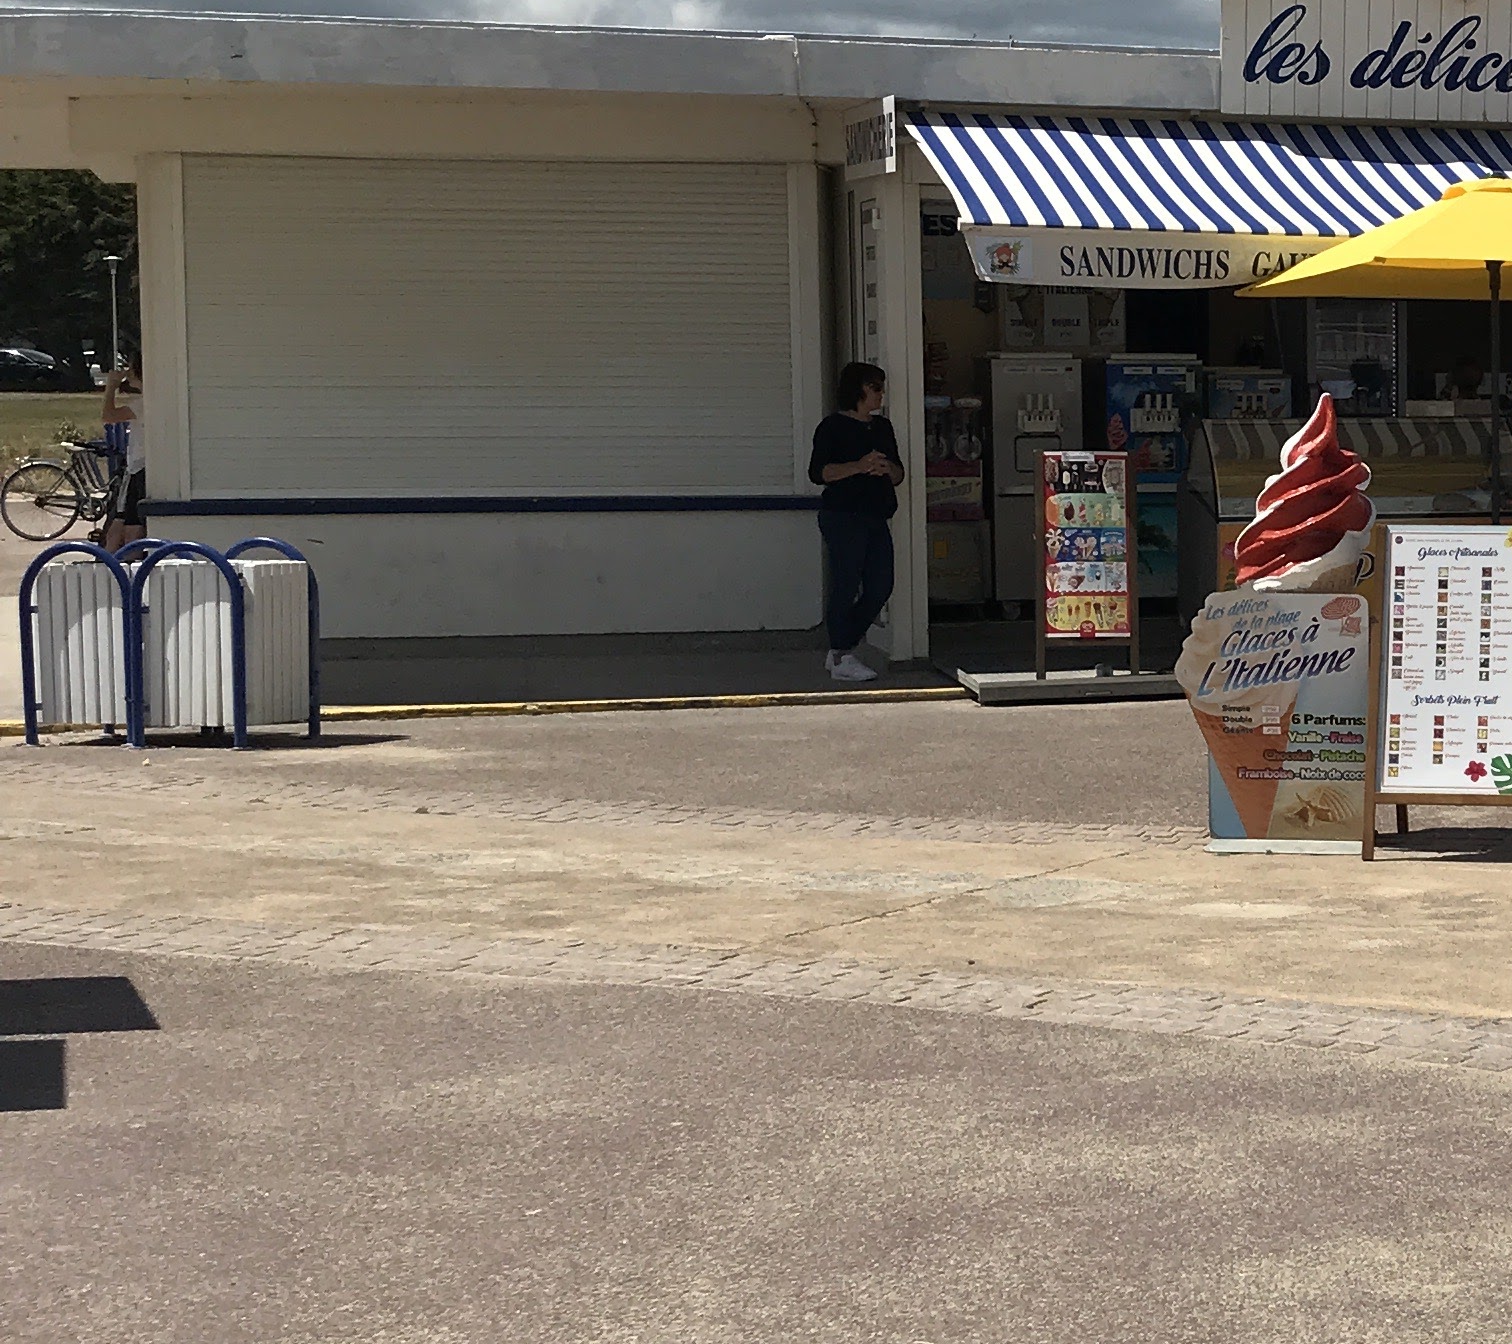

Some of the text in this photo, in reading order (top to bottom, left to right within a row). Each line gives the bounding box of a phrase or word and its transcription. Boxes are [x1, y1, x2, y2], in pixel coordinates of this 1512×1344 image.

[1243, 5, 1331, 86] les
[1060, 245, 1230, 280] SANDWICHS
[1418, 547, 1447, 561] Glaces
[1206, 599, 1269, 620] Les délices
[1232, 610, 1301, 630] de la plage
[1220, 617, 1320, 657] Glaces à
[1197, 647, 1356, 697] L'Italienne
[1447, 695, 1471, 706] Plein
[1291, 714, 1300, 725] 6
[1288, 731, 1323, 743] Vanille
[1329, 731, 1364, 744] Fraise
[1263, 749, 1313, 761] Chocolat
[1319, 750, 1366, 762] Pistache
[1237, 767, 1294, 779] Framboise
[1300, 767, 1327, 780] Noix
[1328, 768, 1341, 780] de
